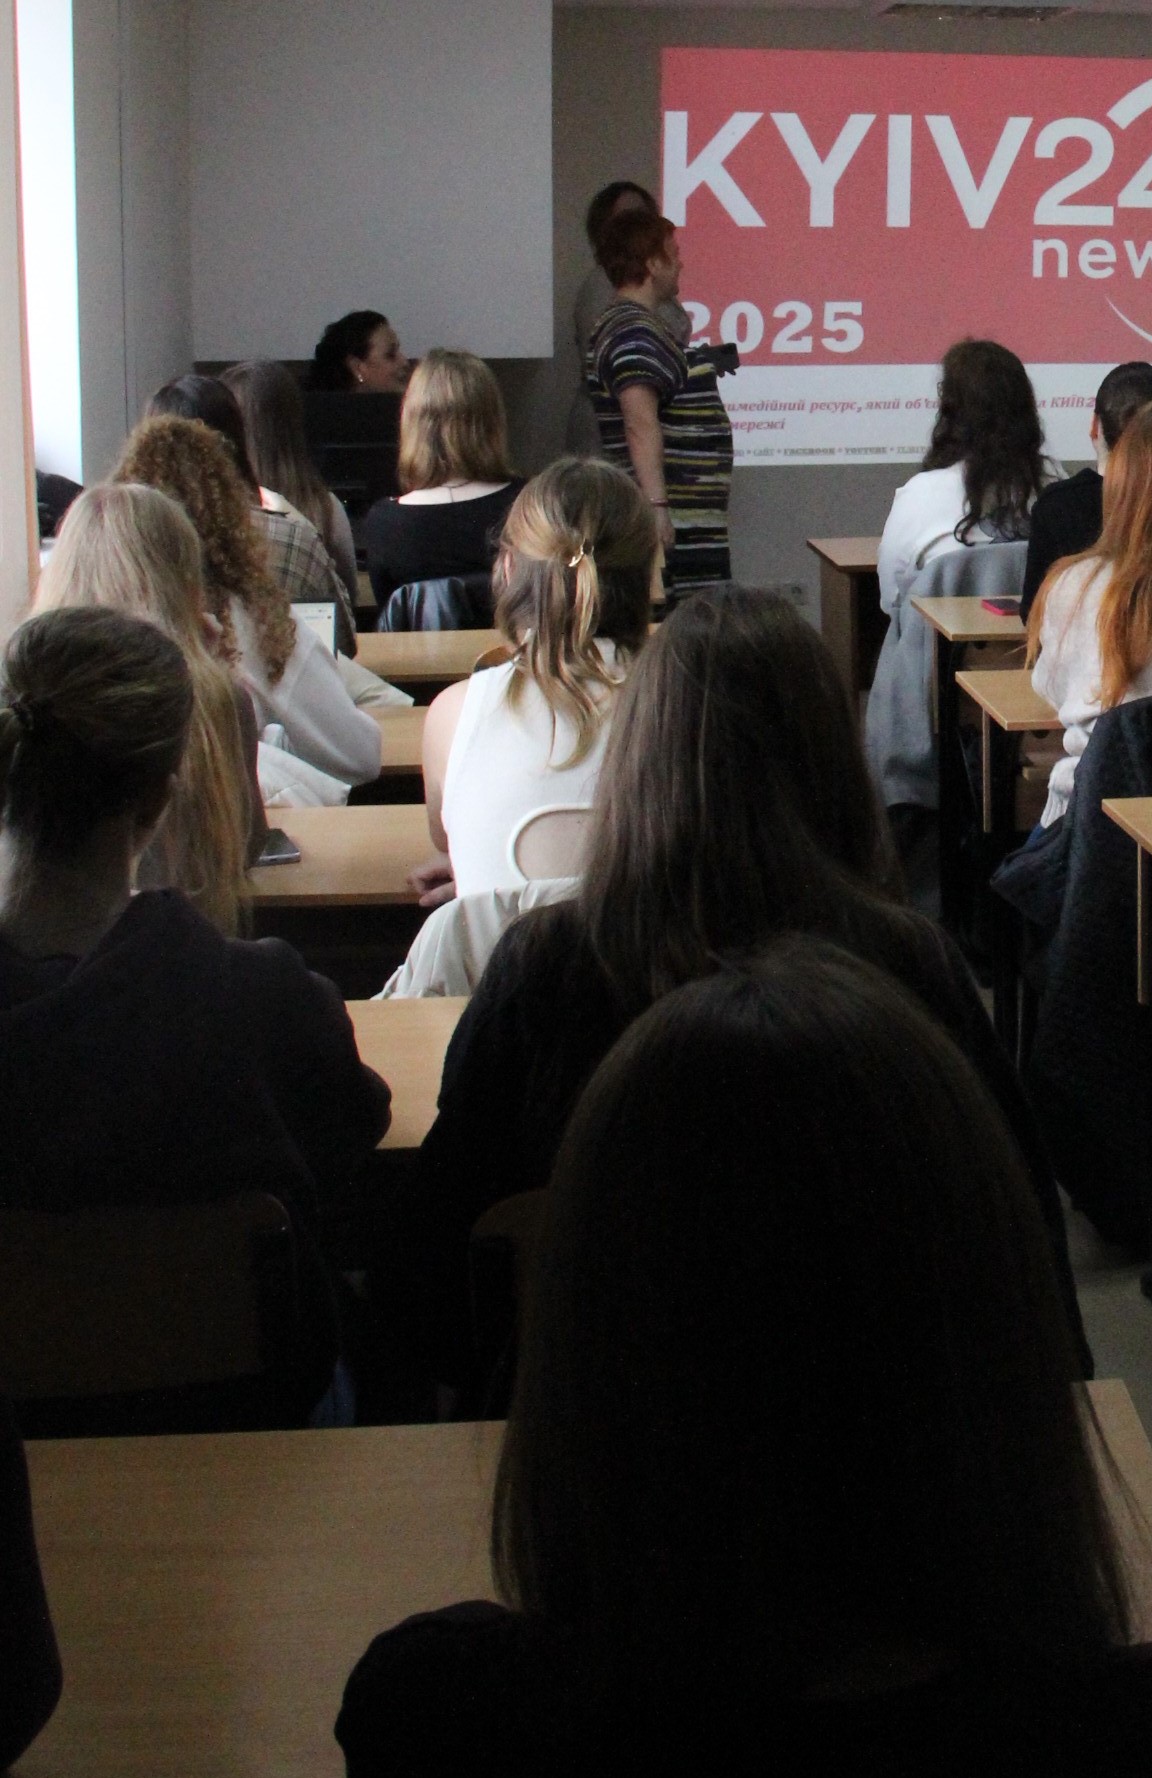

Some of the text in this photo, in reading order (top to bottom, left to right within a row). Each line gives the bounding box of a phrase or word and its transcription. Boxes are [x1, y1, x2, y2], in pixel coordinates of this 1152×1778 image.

[682, 300, 865, 353] 2025
[724, 399, 805, 412] имедійний
[865, 398, 901, 410] який
[1050, 395, 1097, 408] КИЇВ2
